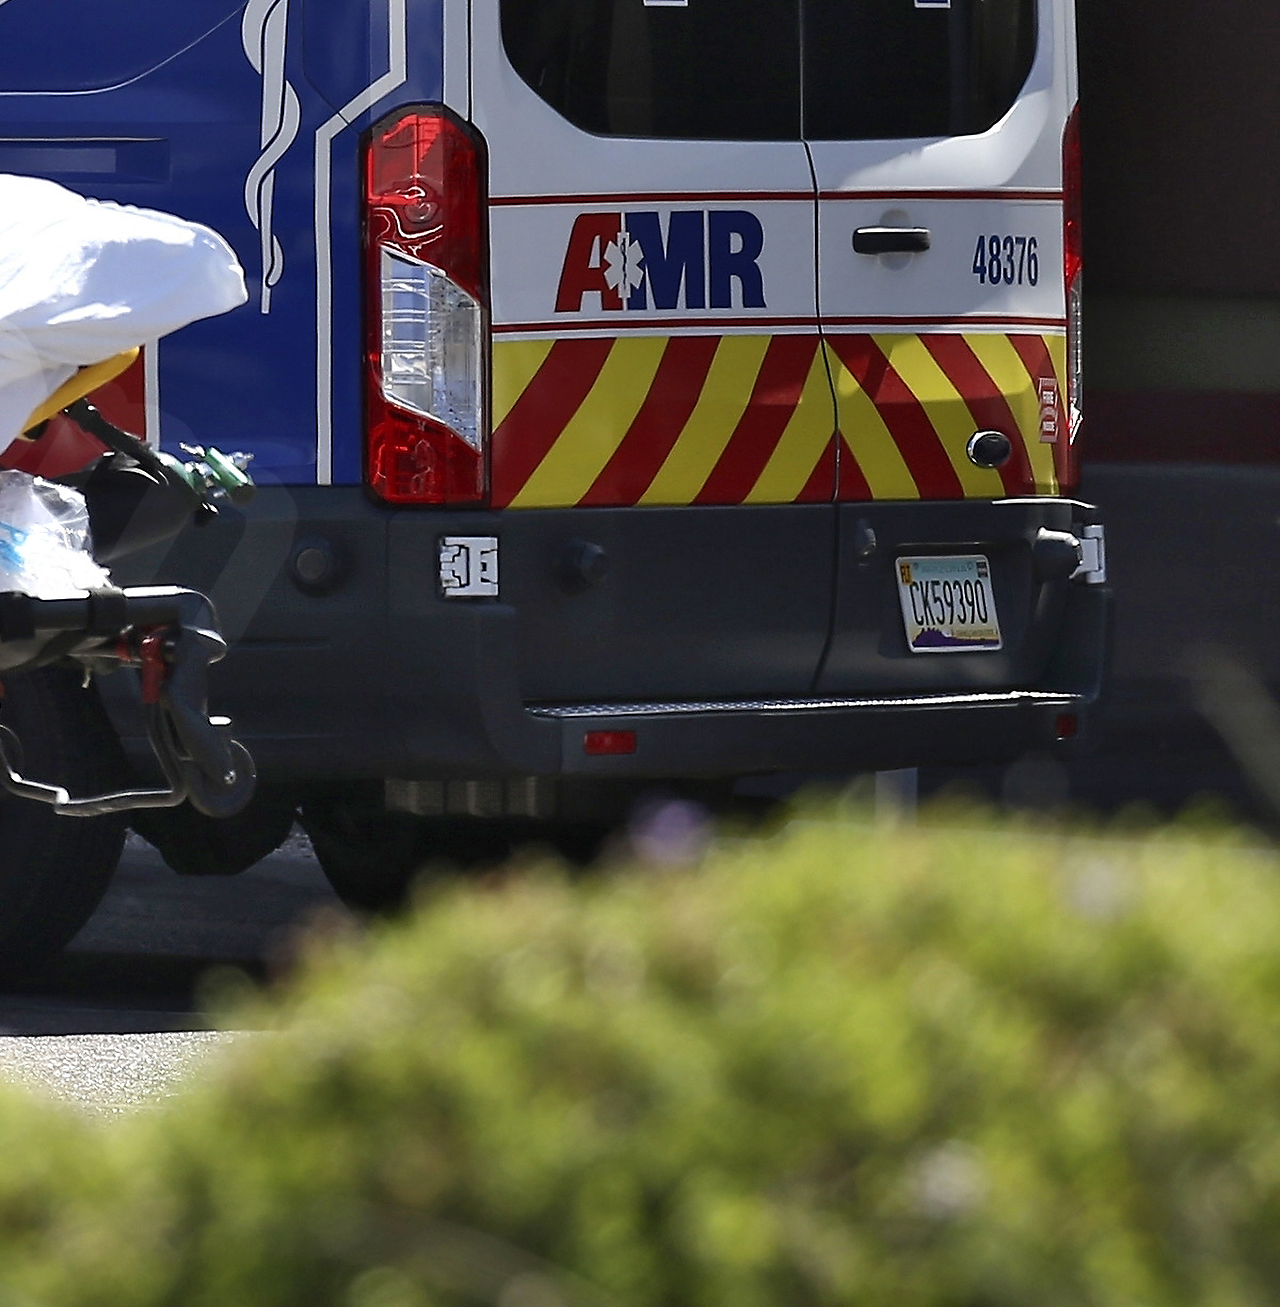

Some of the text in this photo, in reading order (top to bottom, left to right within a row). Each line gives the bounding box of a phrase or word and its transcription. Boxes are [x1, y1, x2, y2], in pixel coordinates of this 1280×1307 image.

[554, 209, 767, 313] AMR
[971, 234, 1039, 287] 48376
[909, 578, 988, 626] CK59390
